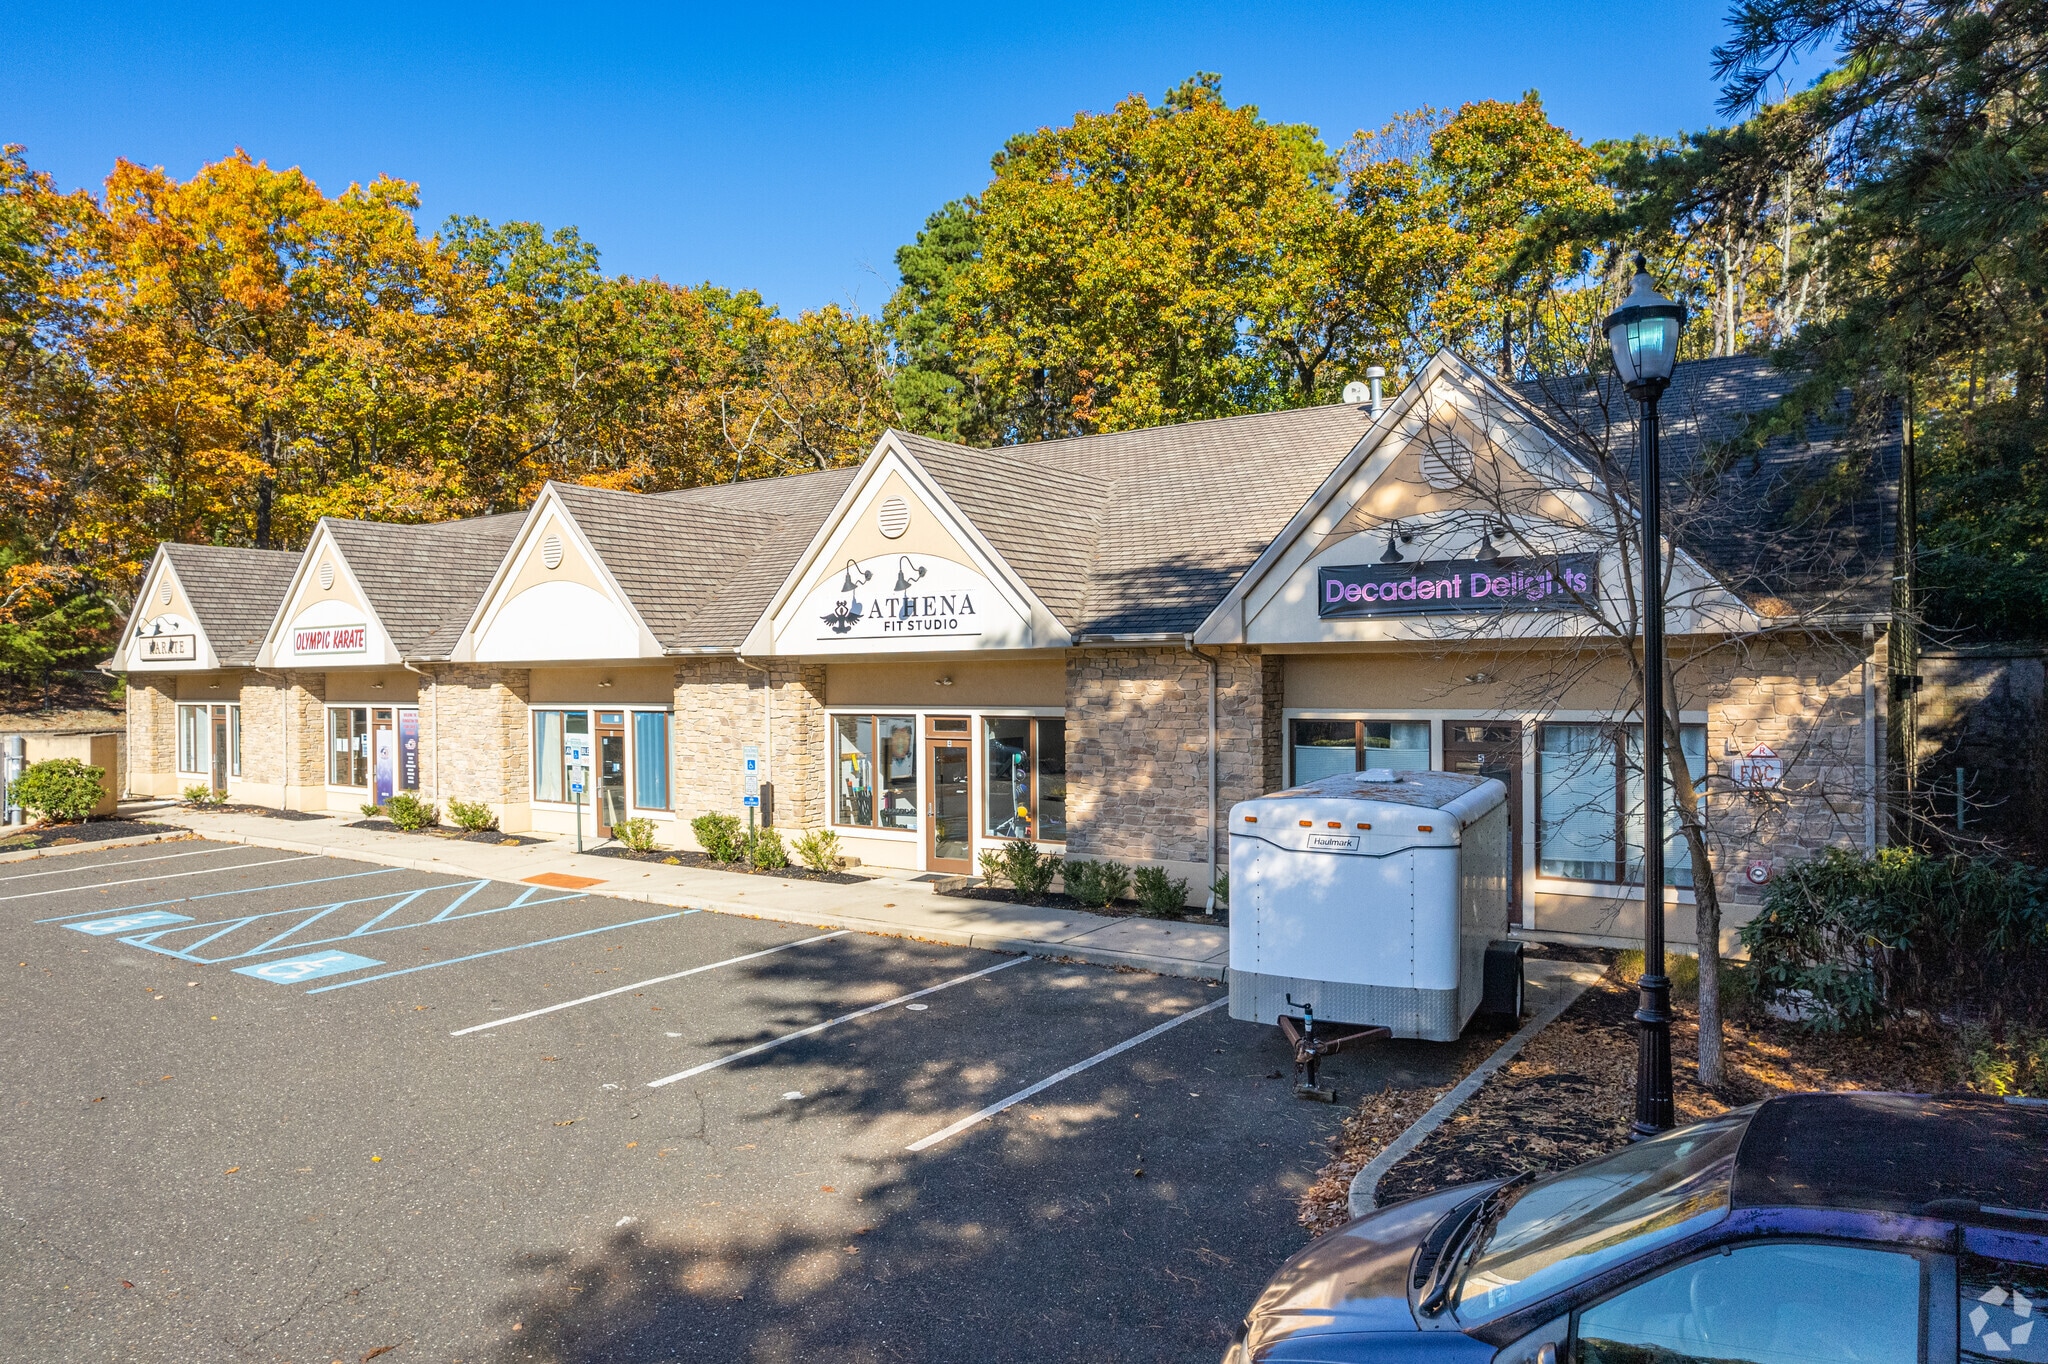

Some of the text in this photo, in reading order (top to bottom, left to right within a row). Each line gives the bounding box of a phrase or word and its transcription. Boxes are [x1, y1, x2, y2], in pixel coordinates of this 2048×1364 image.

[1326, 568, 1587, 603] Decadent Delights
[868, 593, 976, 619] ATHENA
[884, 618, 958, 632] FIT STUDIO
[148, 640, 185, 655] ARTE
[296, 628, 365, 651] OLYMPIC KARATE
[1759, 746, 1766, 755] R
[1740, 765, 1774, 782] FDC
[1313, 837, 1353, 847] Haulmark
